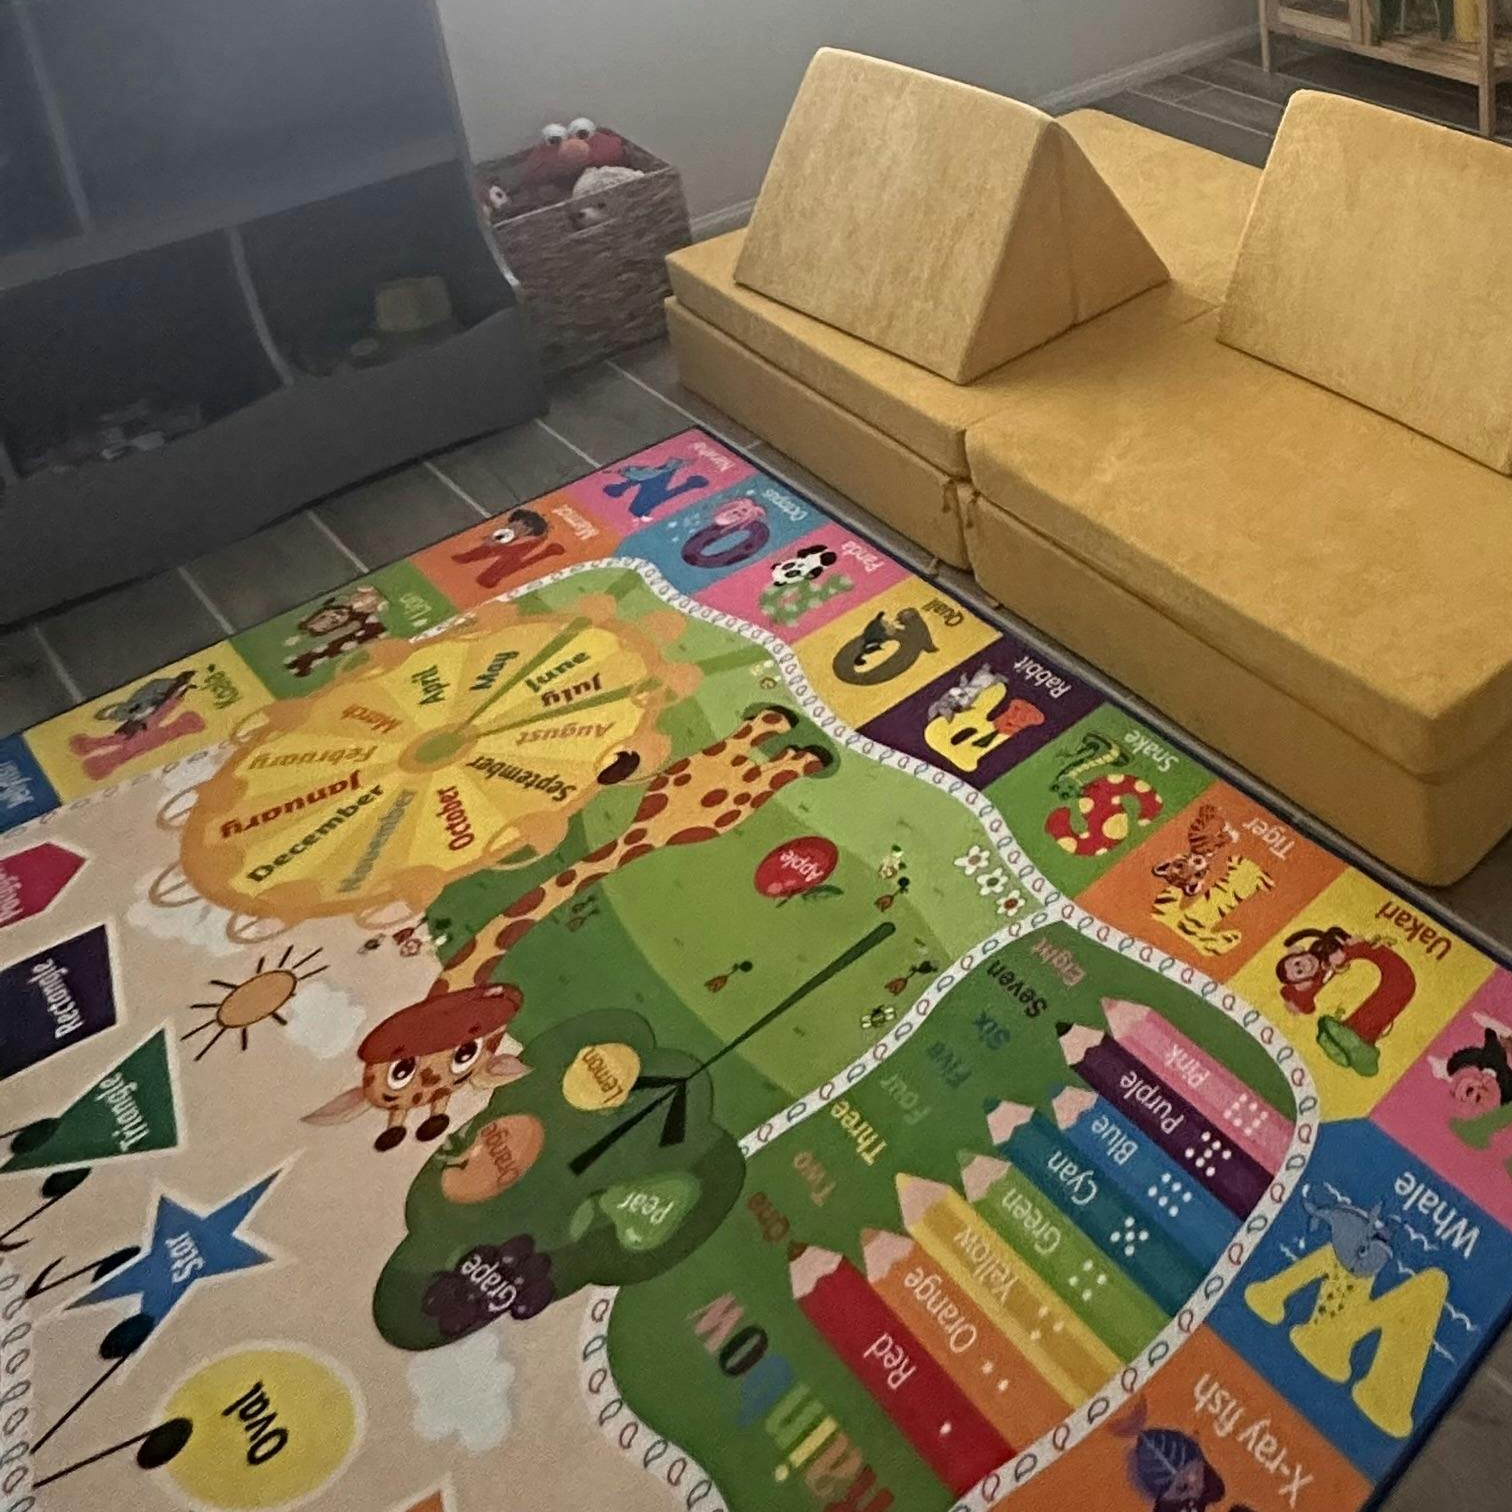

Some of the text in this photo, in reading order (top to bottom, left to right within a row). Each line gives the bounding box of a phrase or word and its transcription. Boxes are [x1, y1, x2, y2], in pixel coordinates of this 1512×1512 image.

[842, 540, 885, 574] Panda
[923, 596, 967, 630] Quail
[411, 664, 450, 706] April
[469, 650, 520, 692] May
[522, 650, 592, 695] June
[540, 673, 603, 708] July
[1013, 654, 1073, 702] Rabbit
[247, 745, 380, 771] February
[513, 721, 618, 747] August
[1122, 727, 1180, 774] Snake
[219, 770, 366, 840] January
[465, 755, 578, 804] September
[246, 783, 386, 884] December
[436, 785, 476, 852] October
[1241, 816, 1296, 865] Tiger
[778, 848, 825, 884] Apple
[1374, 900, 1454, 962] Uakari
[27, 957, 86, 1039] Rectangle
[987, 959, 1048, 1019] Seven
[581, 1046, 624, 1104] Lemon
[1165, 1042, 1210, 1087] Pink
[94, 1071, 151, 1153] Triangle
[879, 1073, 932, 1126] Four
[1119, 1069, 1185, 1136] Purple
[481, 1121, 522, 1186] Orange
[829, 1099, 888, 1167] Three
[1091, 1113, 1139, 1166] Blue
[791, 1149, 837, 1208] Two
[1047, 1149, 1098, 1206] Cyan
[616, 1191, 675, 1226] Pear
[1001, 1188, 1062, 1256] Green
[1393, 1169, 1481, 1260] Whale
[165, 1231, 207, 1284] Star
[460, 1252, 517, 1313] Grape
[953, 1226, 1022, 1301] Yellow
[903, 1266, 978, 1354] Orange
[863, 1333, 918, 1390] Red
[220, 1379, 289, 1467] Oval
[1193, 1373, 1314, 1509] X-ray fish
